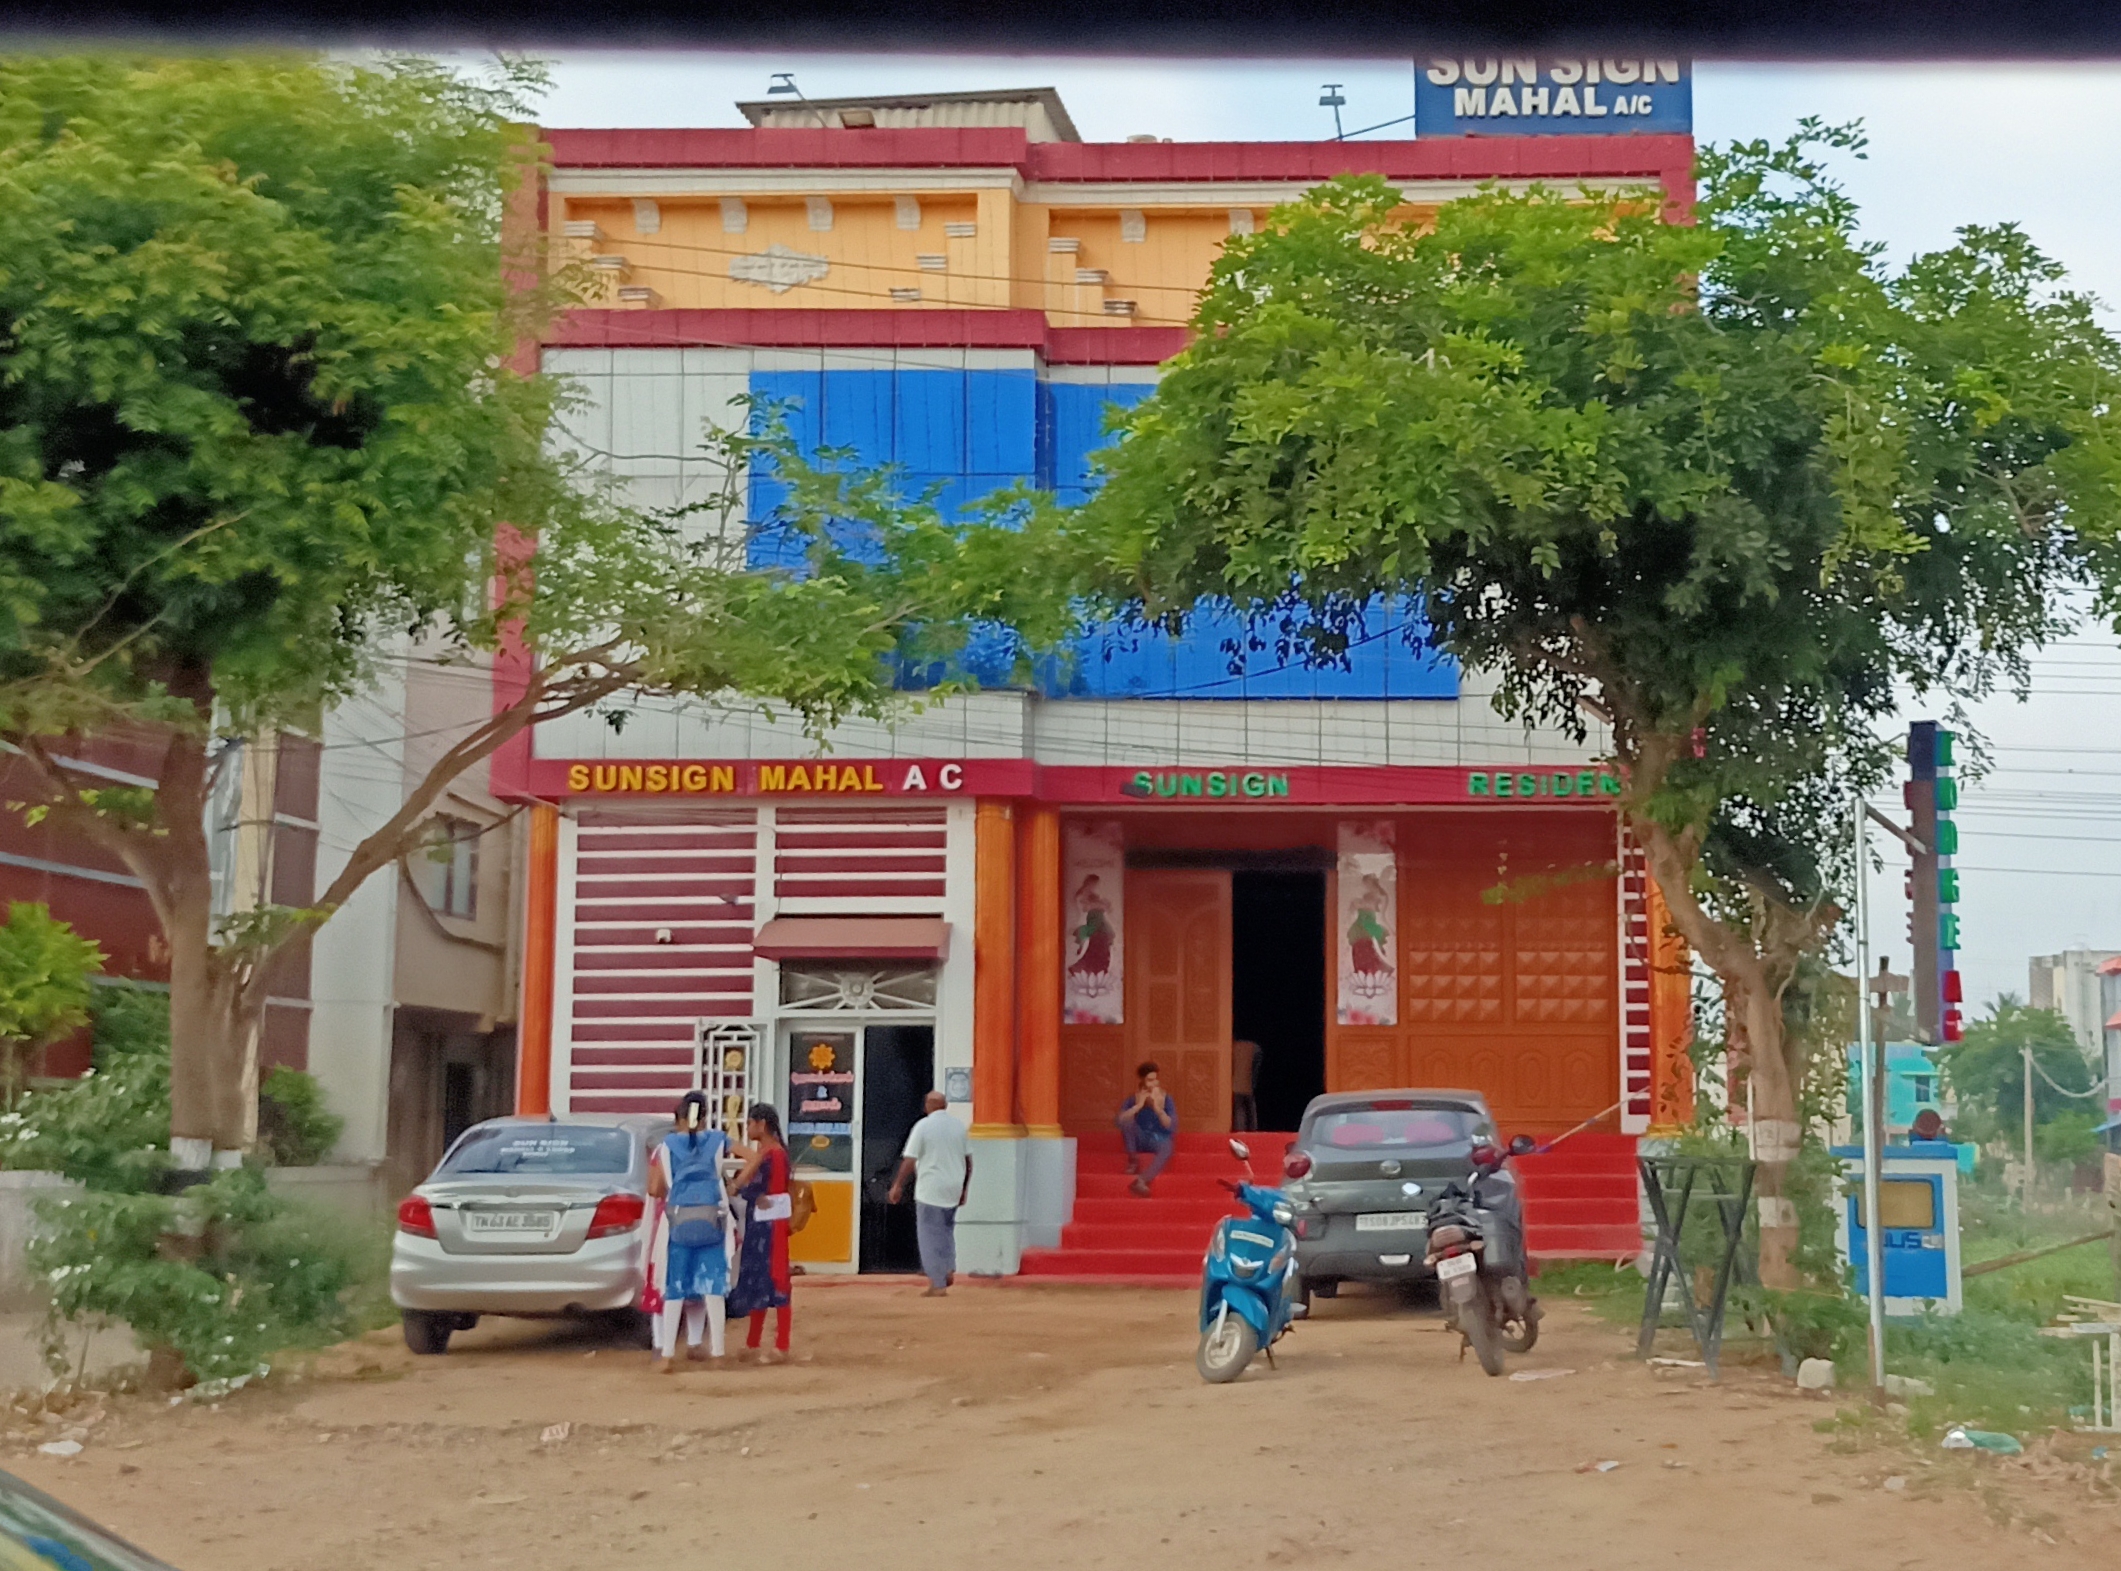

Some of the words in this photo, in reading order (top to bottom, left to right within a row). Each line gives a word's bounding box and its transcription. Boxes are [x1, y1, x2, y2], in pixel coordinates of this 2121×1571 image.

[1427, 57, 1537, 86] SUN
[1550, 57, 1680, 85] SIGN
[1454, 86, 1608, 117] MAHAL
[1613, 95, 1653, 115] A/C
[567, 763, 735, 792] SUNSIGN
[759, 764, 884, 792] MAHAL
[1133, 770, 1289, 798] SUNSIGN
